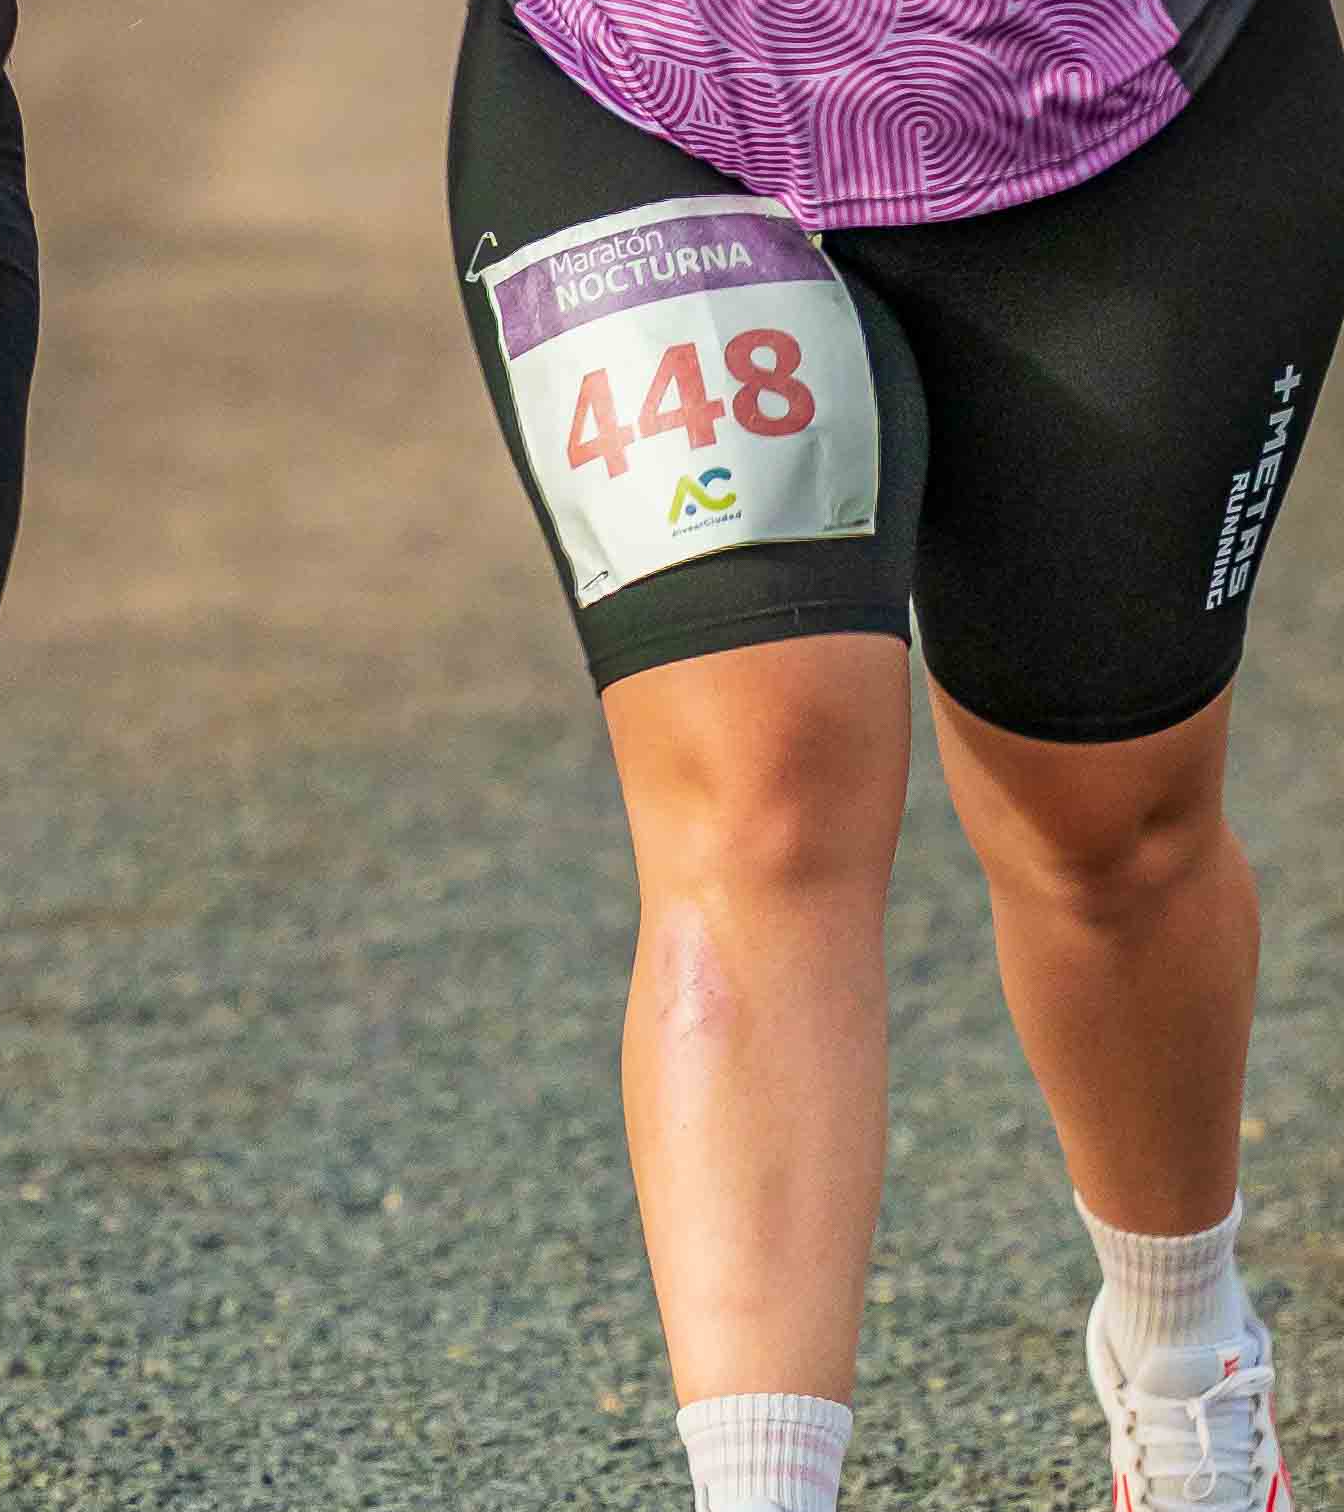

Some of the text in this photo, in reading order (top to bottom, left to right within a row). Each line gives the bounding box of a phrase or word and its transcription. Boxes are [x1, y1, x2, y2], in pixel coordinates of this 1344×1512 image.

[548, 224, 664, 281] Maratón
[555, 240, 753, 313] NOCTURNA
[567, 328, 816, 479] 448
[1205, 471, 1251, 611] RUNNING
